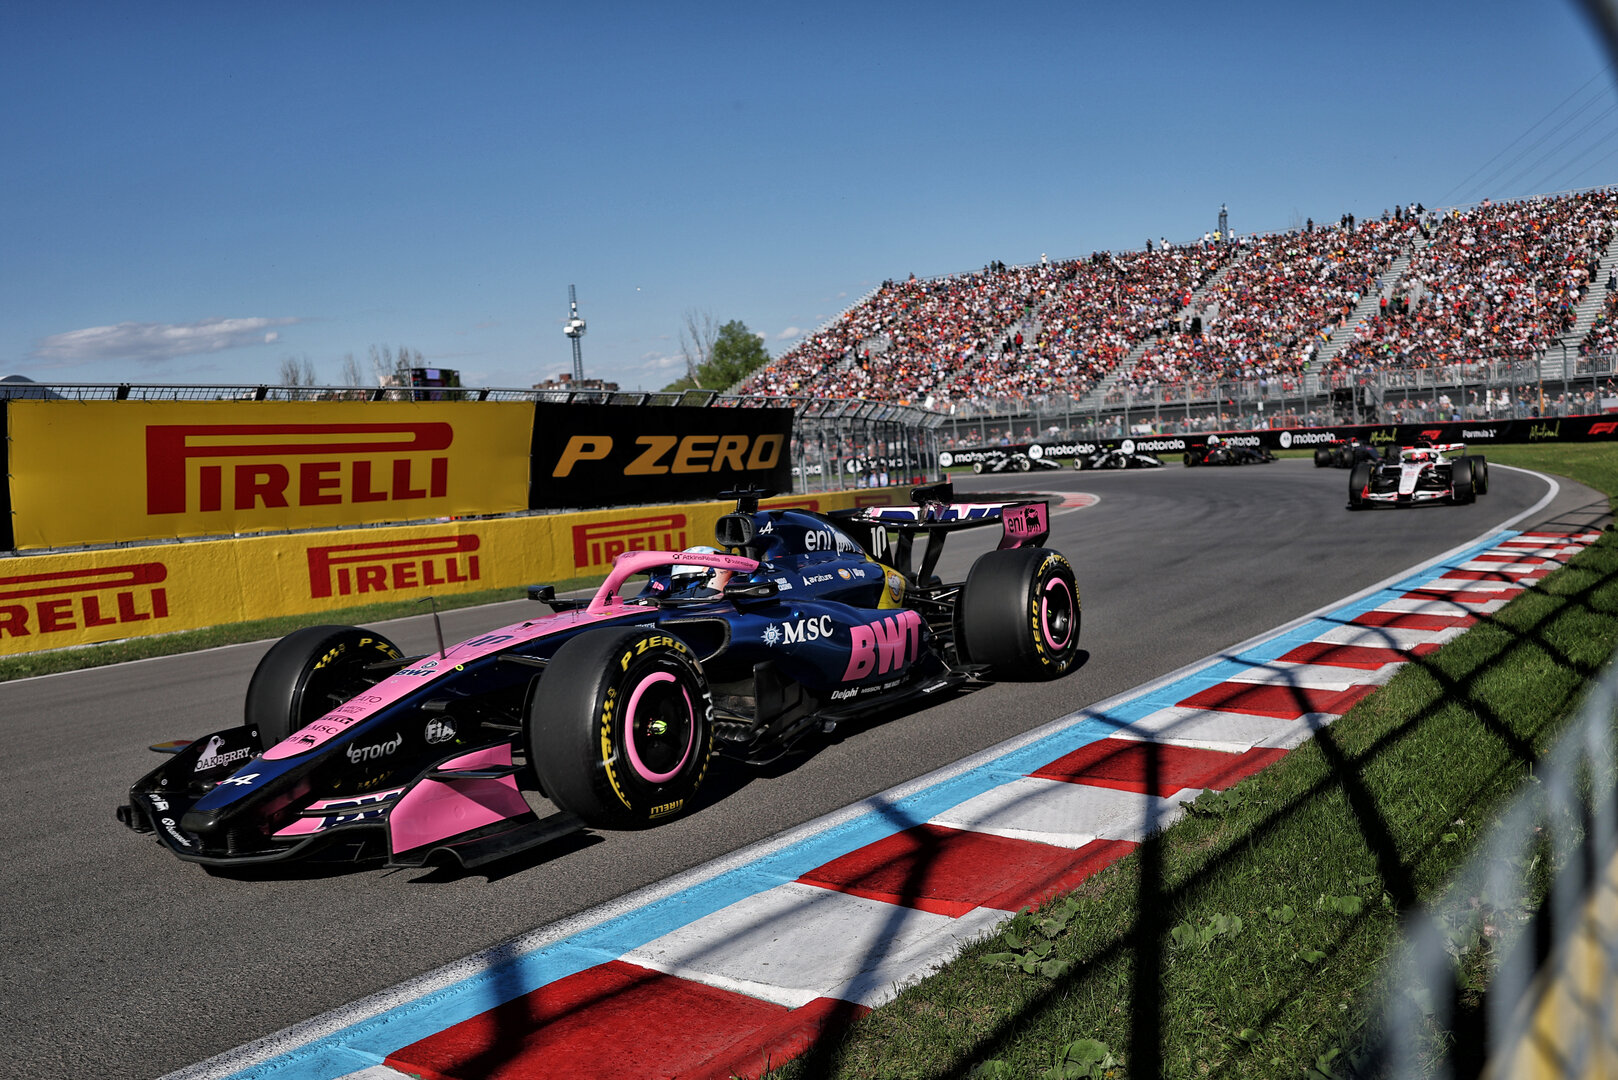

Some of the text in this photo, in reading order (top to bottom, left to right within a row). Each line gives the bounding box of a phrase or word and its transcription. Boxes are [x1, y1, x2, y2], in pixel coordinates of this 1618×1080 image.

[1136, 439, 1186, 451] motorola
[1462, 429, 1489, 438] Formula
[552, 434, 785, 477] P ZERO
[1044, 443, 1096, 456] motorola
[146, 422, 454, 515] PIRELLI
[1008, 511, 1025, 533] eni
[572, 513, 687, 567] PIRELLI
[805, 530, 831, 551] eni
[870, 525, 887, 559] 10
[307, 535, 480, 599] PIRELLI
[0, 562, 169, 639] RELLI
[781, 614, 834, 645] MSC
[1032, 599, 1045, 654] ZERO
[359, 638, 401, 660] P ZE
[621, 635, 687, 672] P ZERO
[841, 609, 922, 682] BWT
[831, 686, 860, 700] Delphi
[308, 724, 339, 735] MSC
[321, 715, 354, 724] ELLI
[196, 747, 251, 770] OAKBERRY
[649, 799, 684, 819] PIRELLI
